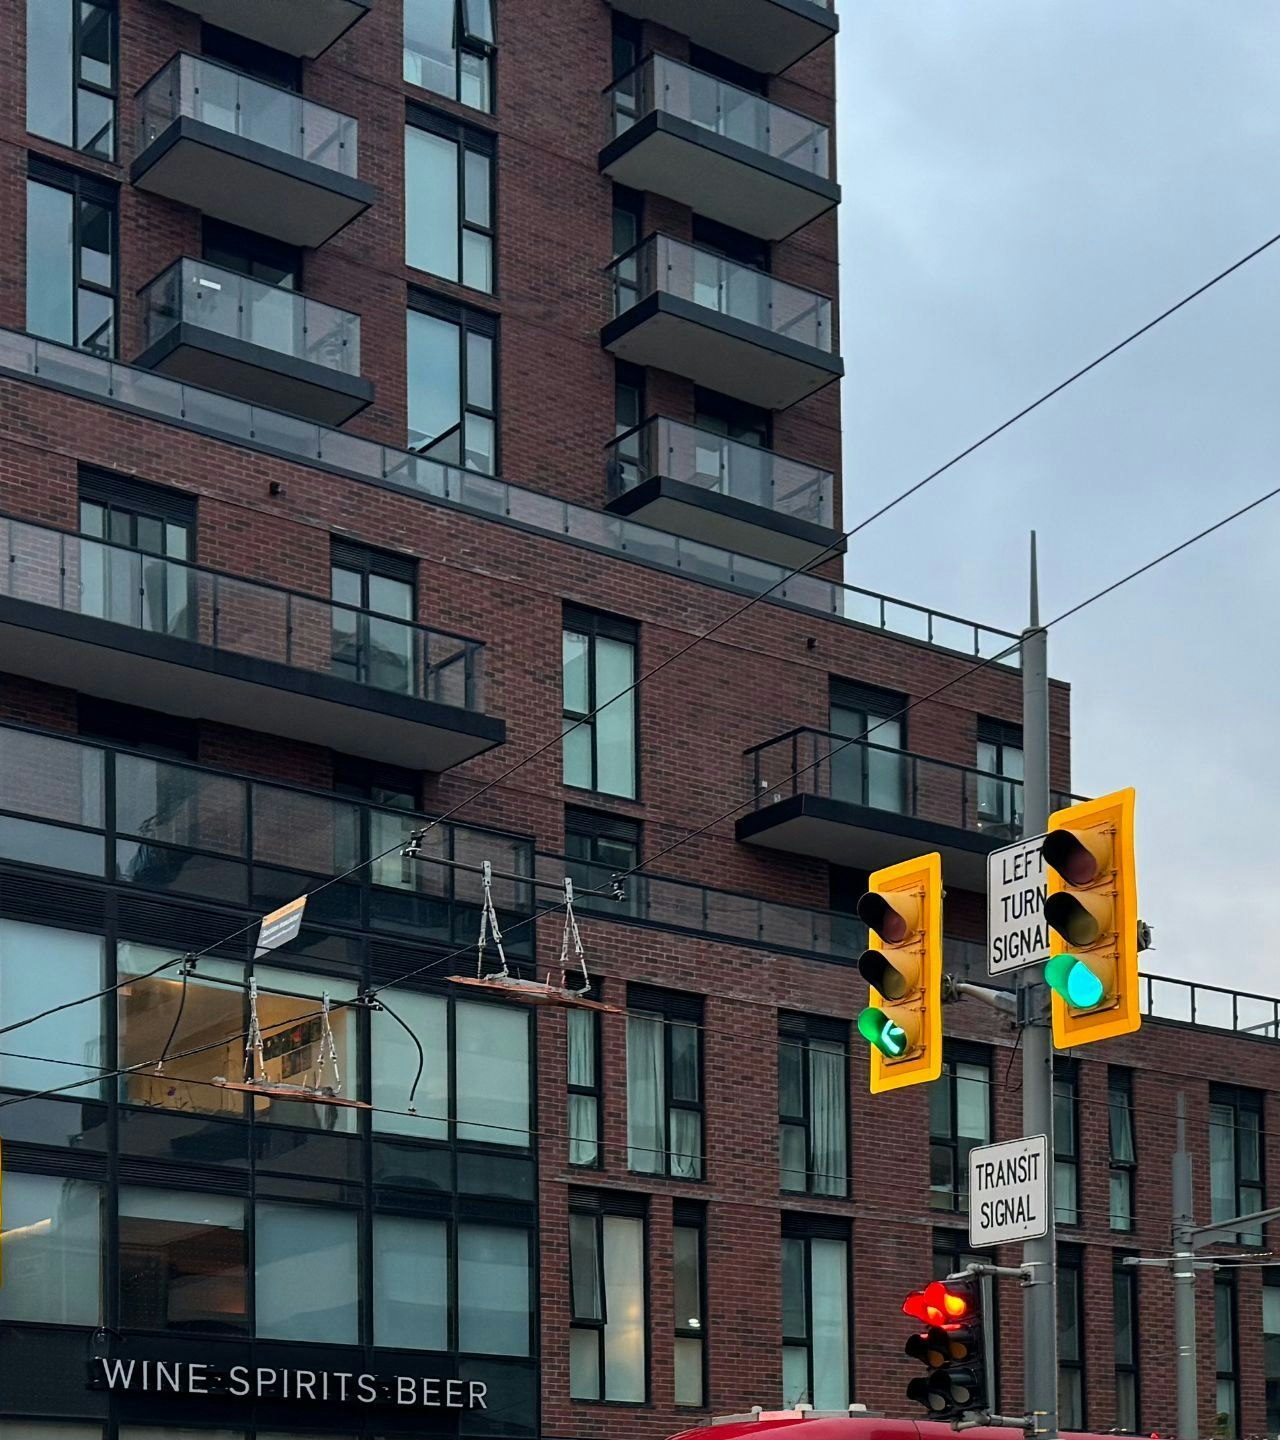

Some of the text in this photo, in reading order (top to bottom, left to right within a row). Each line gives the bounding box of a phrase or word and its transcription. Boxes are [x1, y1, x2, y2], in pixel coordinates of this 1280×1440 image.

[1002, 846, 1043, 885] LEFT
[1001, 884, 1047, 922] TURN
[992, 920, 1050, 963] SIGNAL
[975, 1153, 1041, 1192] TRANSIT
[980, 1193, 1036, 1229] SIGNAL
[102, 1358, 488, 1410] WINE SPIRITS BEER
